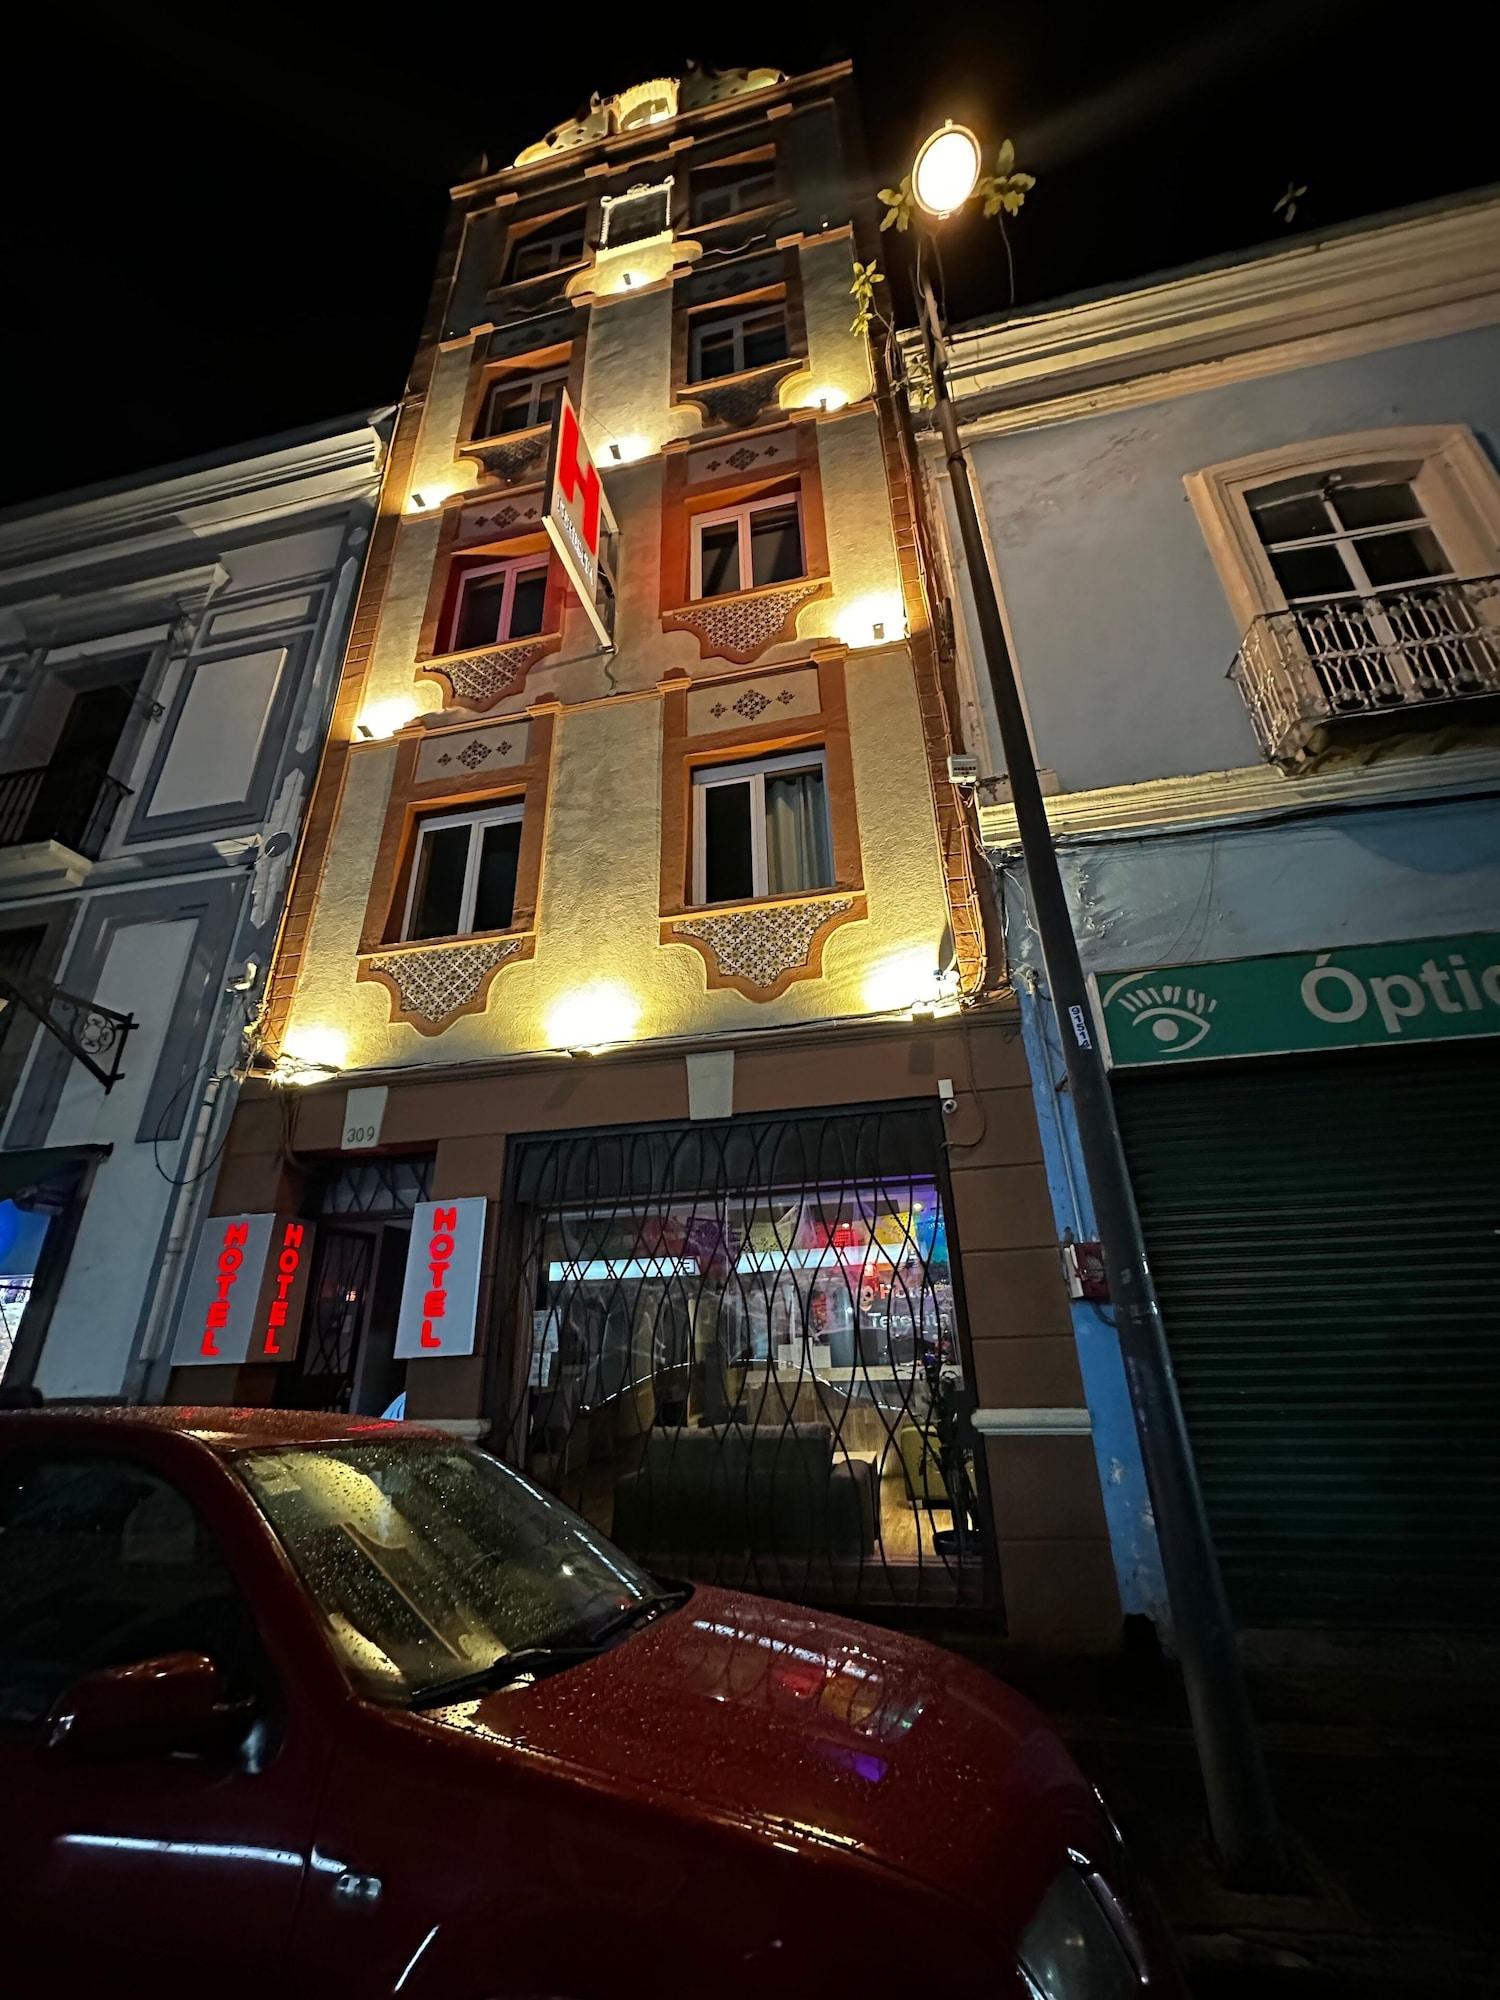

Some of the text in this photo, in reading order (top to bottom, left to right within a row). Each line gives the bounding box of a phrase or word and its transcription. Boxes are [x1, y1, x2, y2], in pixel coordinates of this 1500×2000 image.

[559, 404, 602, 556] H
[346, 1126, 375, 1143] 309
[200, 1222, 249, 1357] HOTEL
[263, 1223, 304, 1354] HOTEL
[420, 1206, 457, 1349] HOTEL
